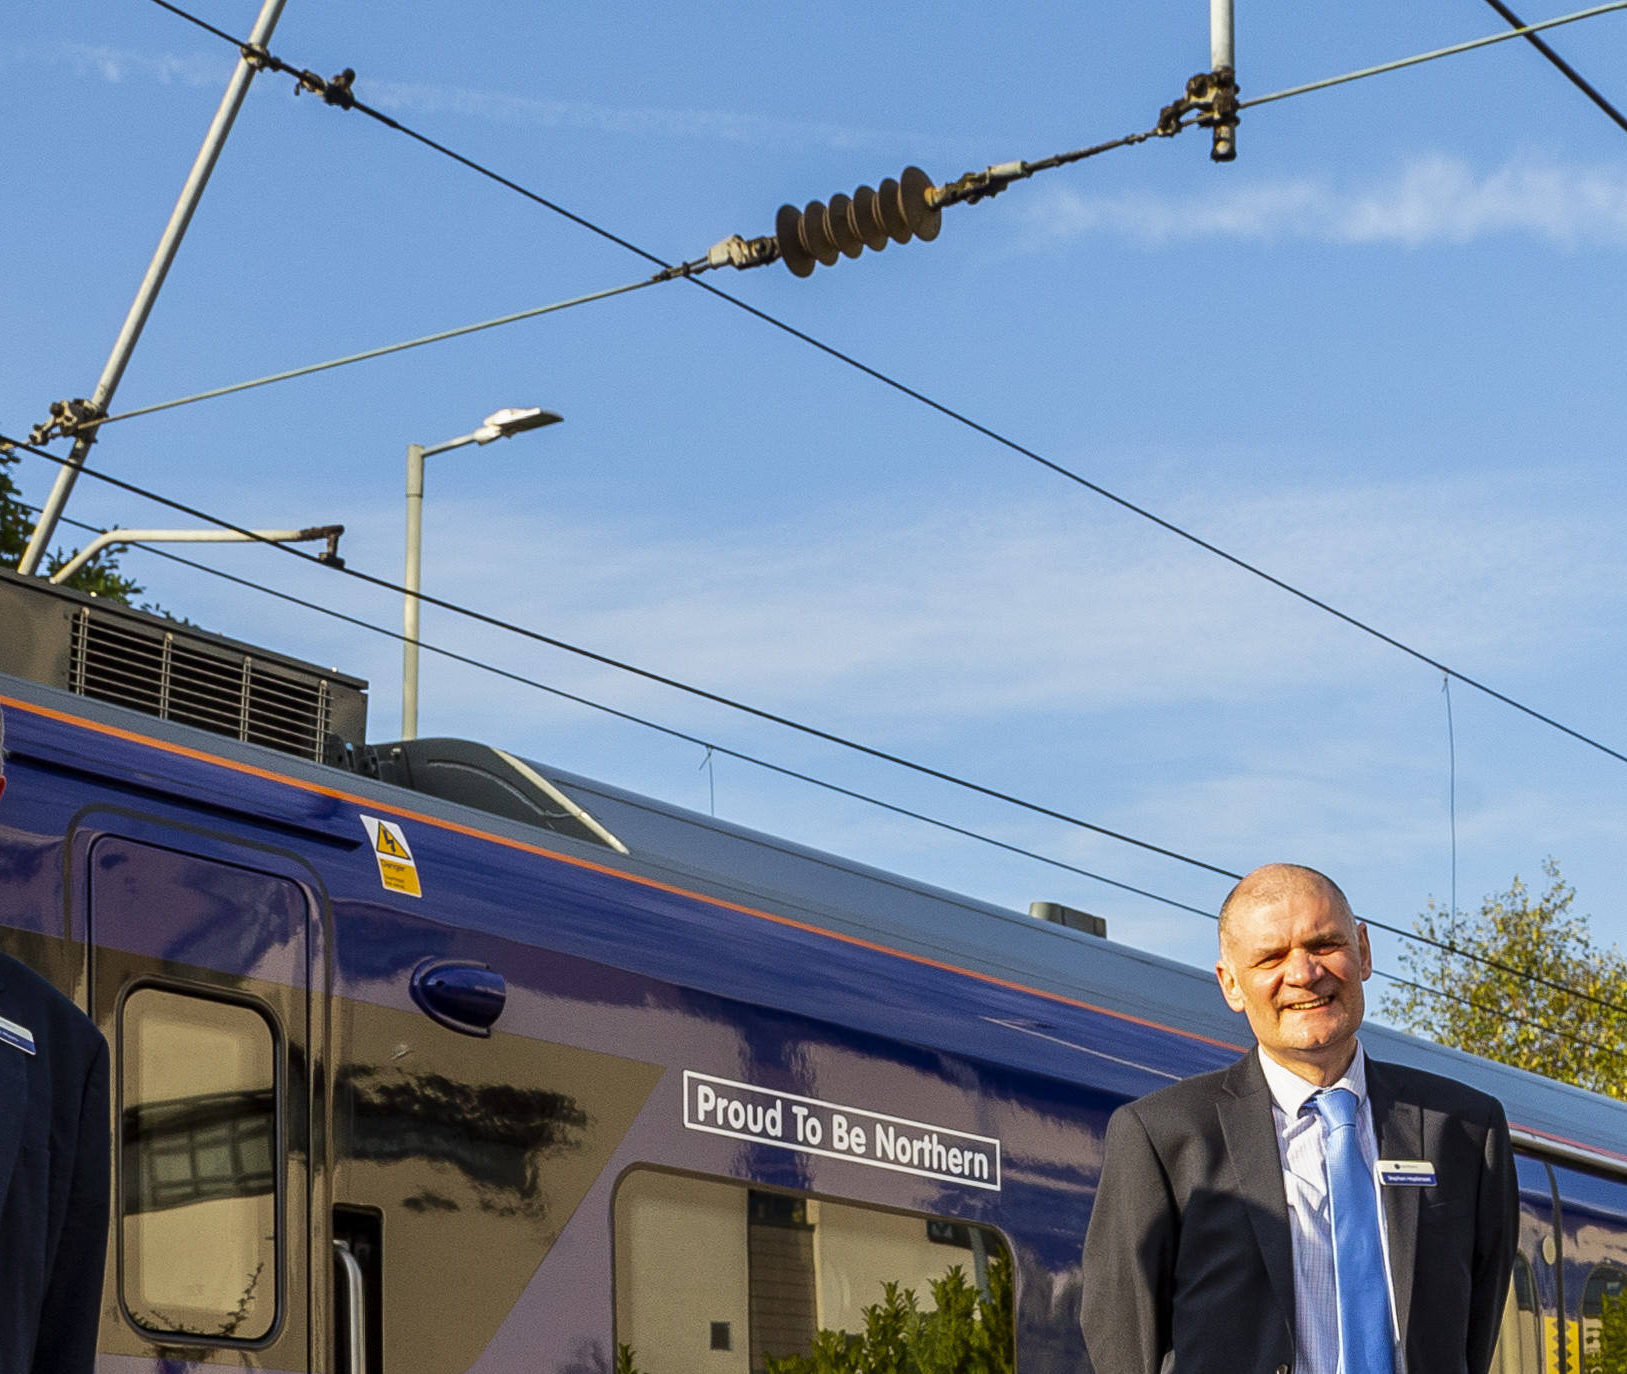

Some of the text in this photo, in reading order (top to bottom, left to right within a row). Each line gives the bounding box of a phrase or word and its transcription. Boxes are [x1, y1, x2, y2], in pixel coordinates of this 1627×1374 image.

[697, 1084, 989, 1180] Proud To Be Northern
